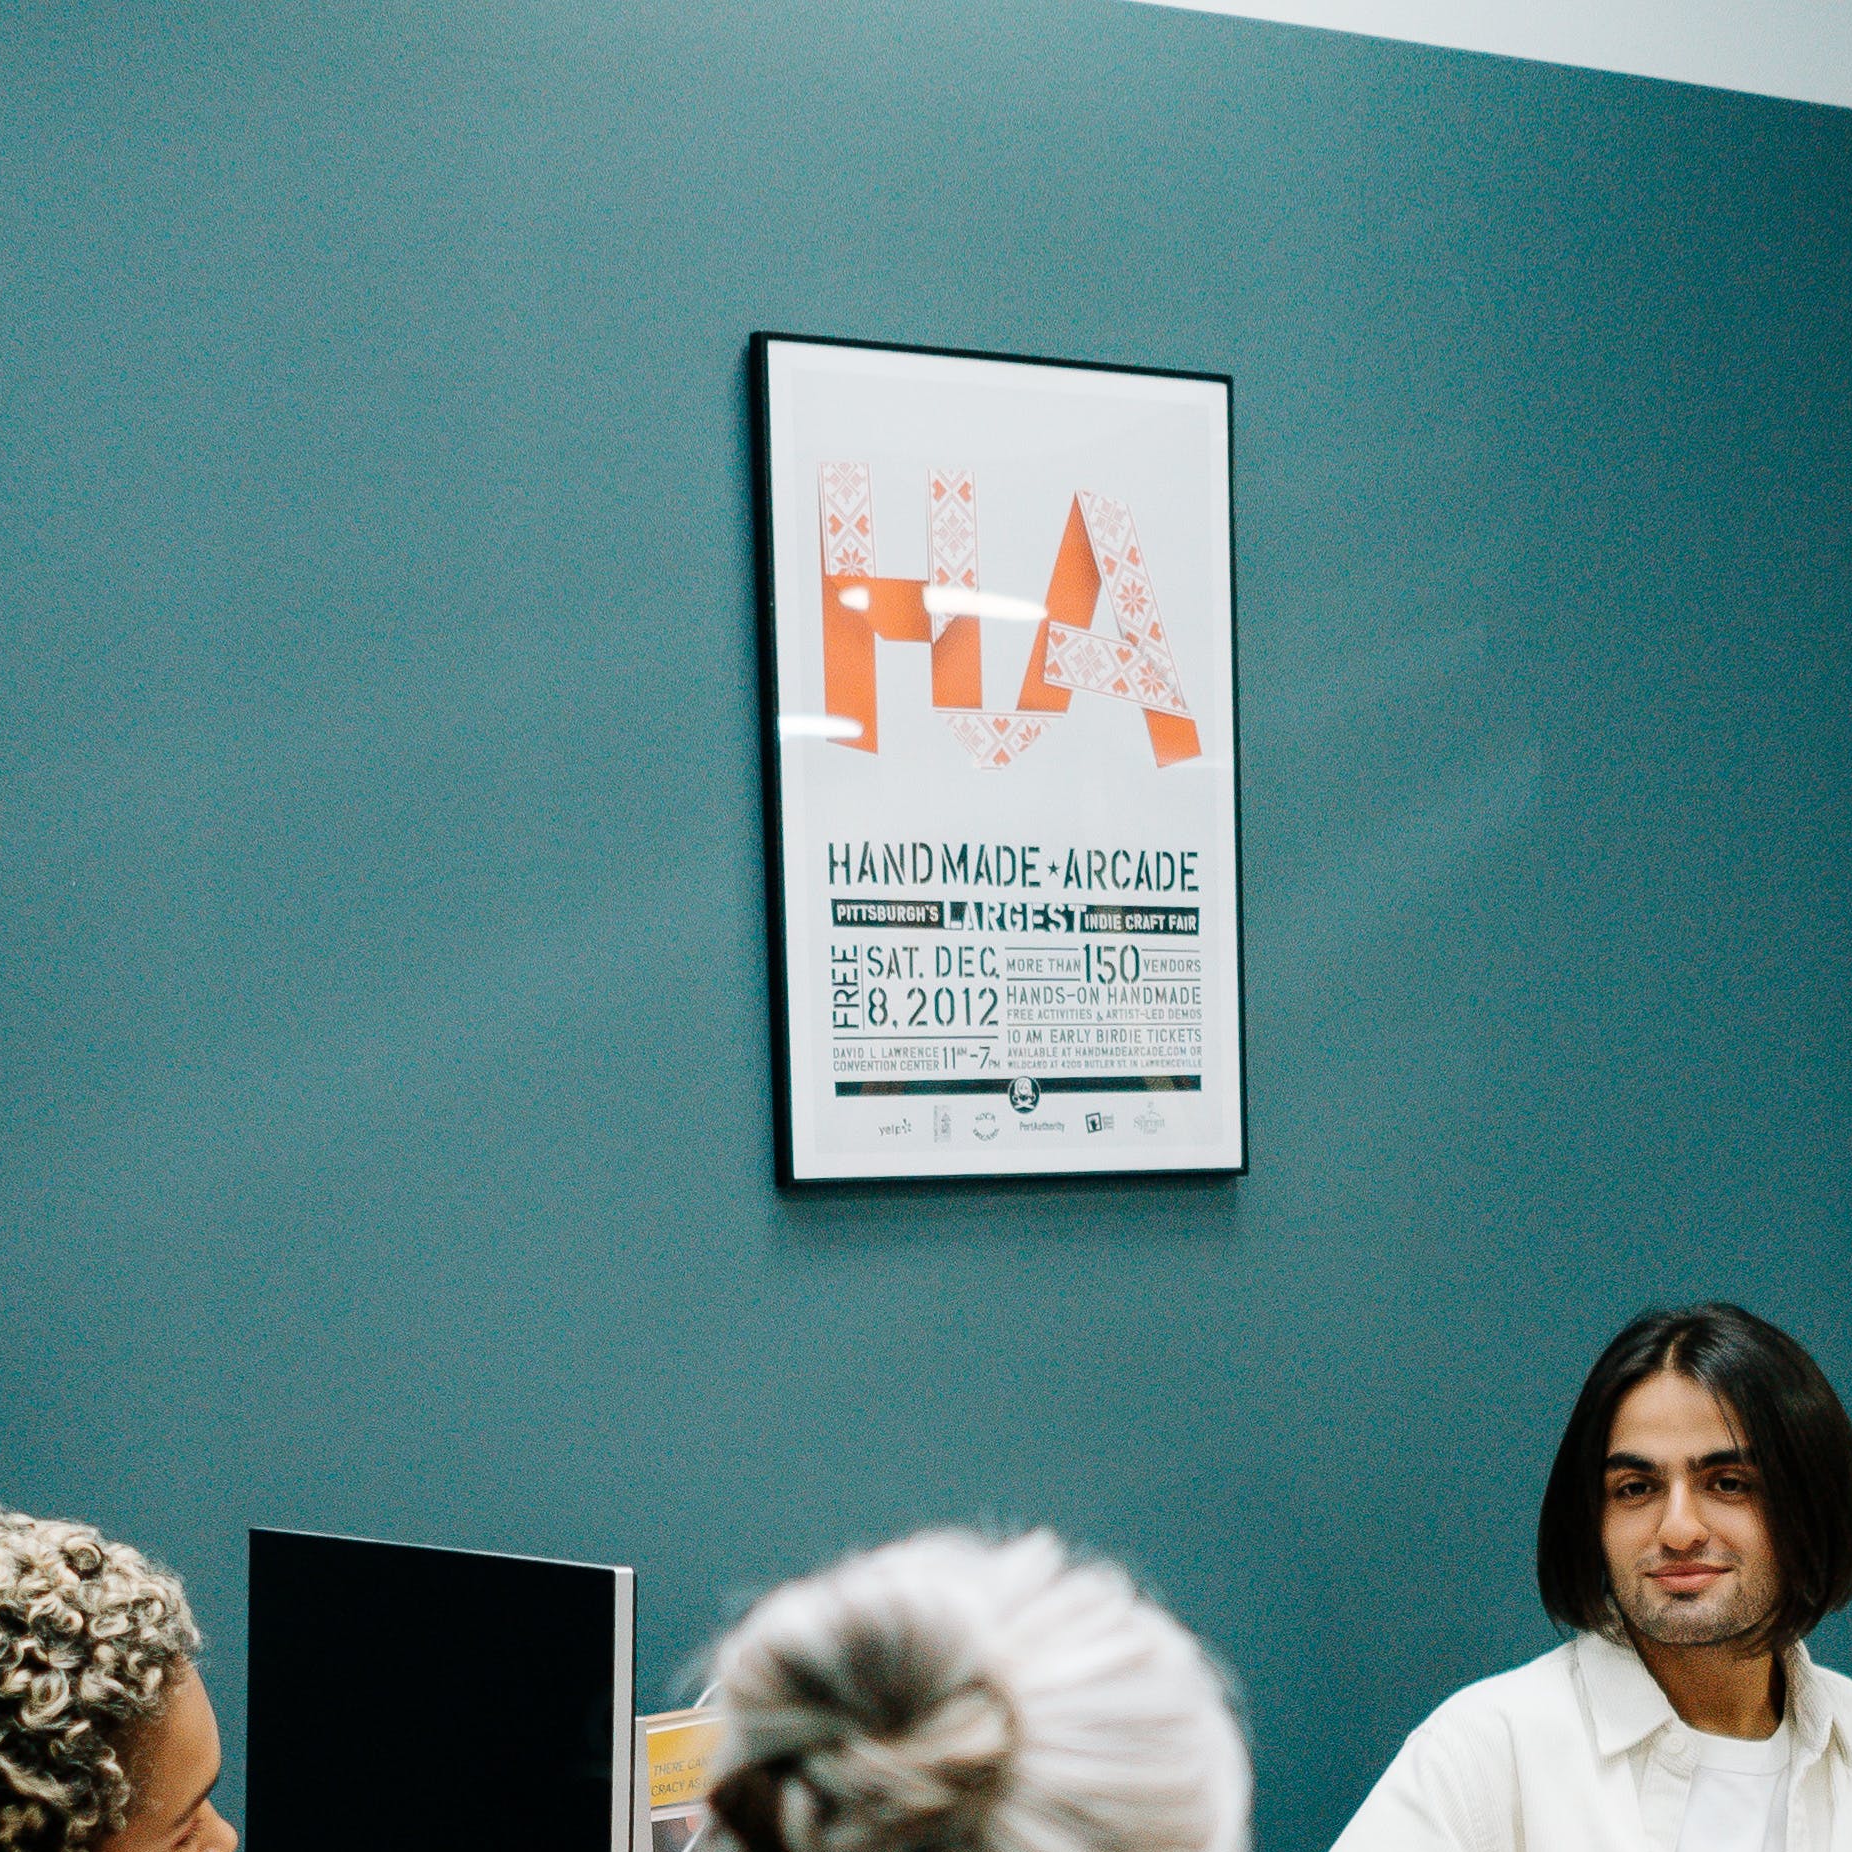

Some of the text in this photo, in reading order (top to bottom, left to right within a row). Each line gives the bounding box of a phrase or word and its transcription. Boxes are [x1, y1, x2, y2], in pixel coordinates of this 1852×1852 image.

[828, 841, 1200, 893] HANDMADE ARCADE
[836, 899, 1197, 933] PITTSBURGH'S LARGEST INDIE CRAFT FAIR
[866, 945, 924, 979] SAT.
[1006, 943, 1201, 985] MORE THAN 150 VENDORS
[831, 944, 860, 1030] FREE
[1006, 985, 1202, 1005] HANDS-ON HANDMADE
[1006, 1008, 1034, 1020] FREE
[1037, 1008, 1093, 1020] ACTIVITIES
[1106, 1008, 1165, 1020] ARTIST-LED
[1168, 1008, 1203, 1020] DEMOS
[1007, 1028, 1202, 1044] 10 AM EARLY BIRDIE TICKETS
[832, 1047, 864, 1059] DAVID
[881, 1047, 939, 1059] LAWRENCE
[1007, 1046, 1202, 1058] AVAILABLE AT HANDMADEARCADE.COM OR
[832, 1059, 939, 1072] CONVENTION CENTER
